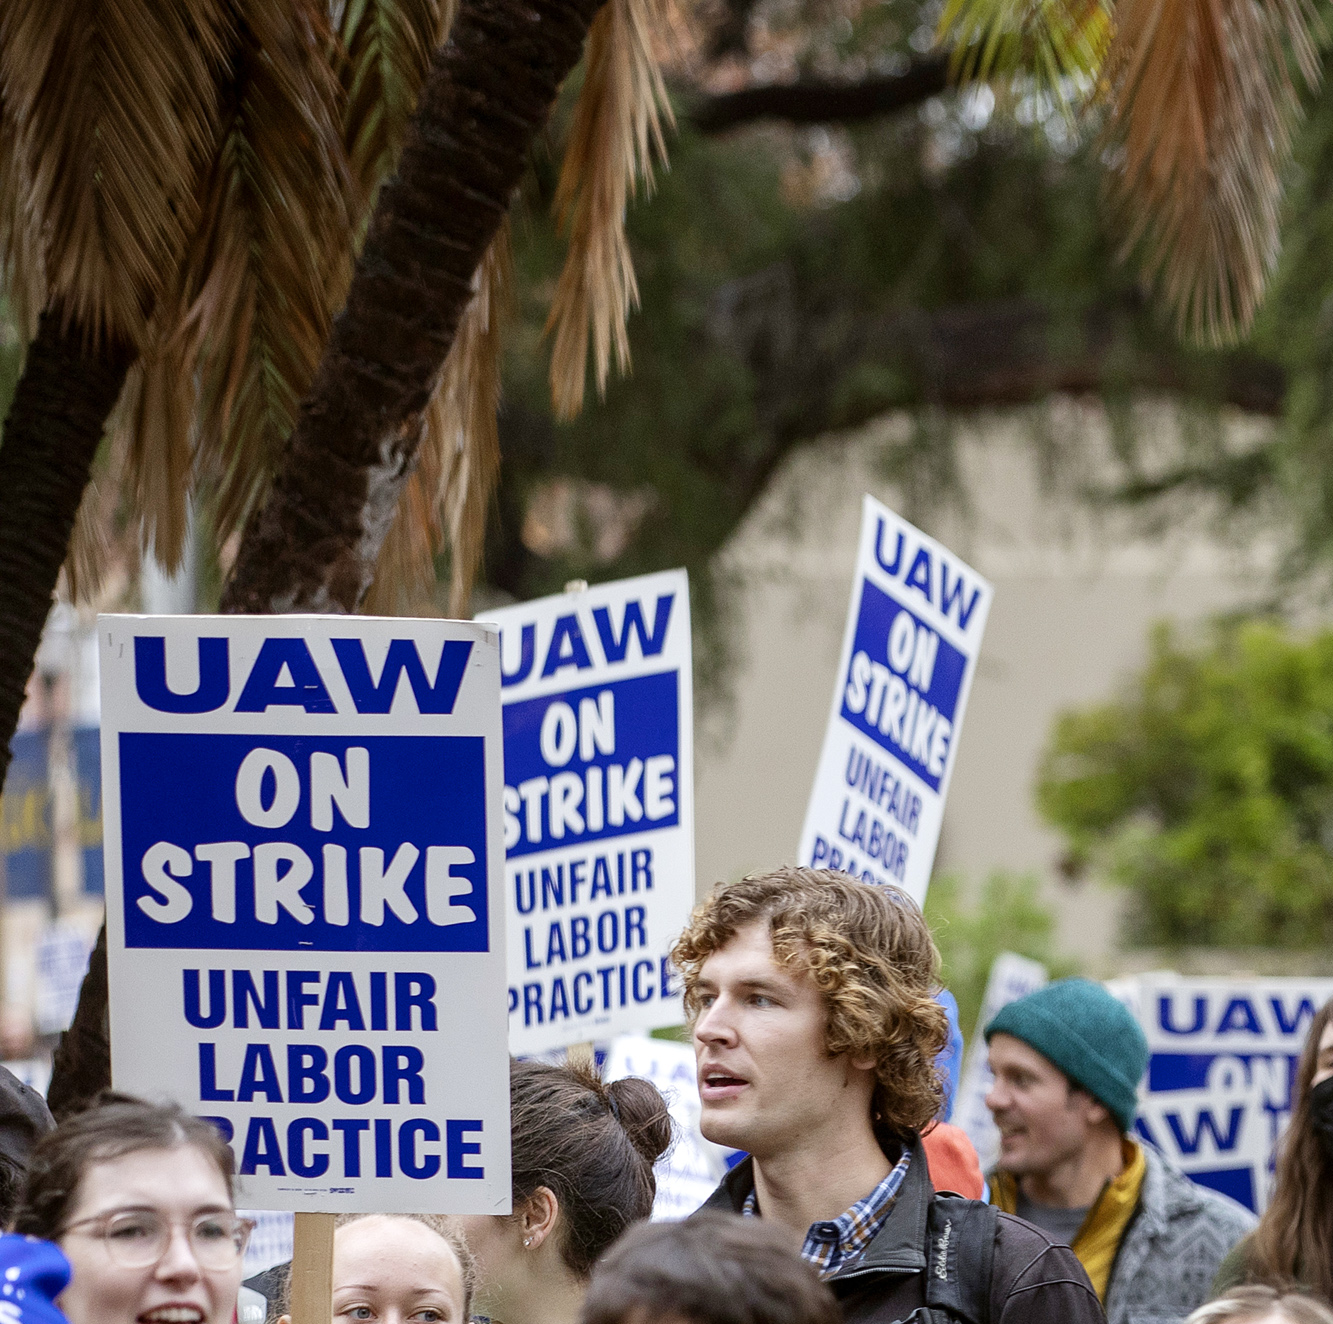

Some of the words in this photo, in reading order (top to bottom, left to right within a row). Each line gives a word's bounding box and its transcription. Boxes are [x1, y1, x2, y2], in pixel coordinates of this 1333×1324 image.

[874, 516, 984, 633] UAW
[133, 636, 475, 714] UAW
[500, 593, 675, 689] UAW
[888, 609, 940, 694] ON
[540, 690, 615, 767] ON
[845, 650, 952, 779] STRIKE
[235, 746, 370, 832] ON
[504, 754, 675, 850] STRIKE
[845, 743, 923, 838] UNFAIR
[838, 795, 910, 883] LABOR
[136, 841, 477, 926] STRIKE
[514, 848, 654, 916] UNFAIR
[523, 904, 648, 972] LABOR
[182, 968, 439, 1032] UNFAIR
[198, 1041, 426, 1105] LABOR
